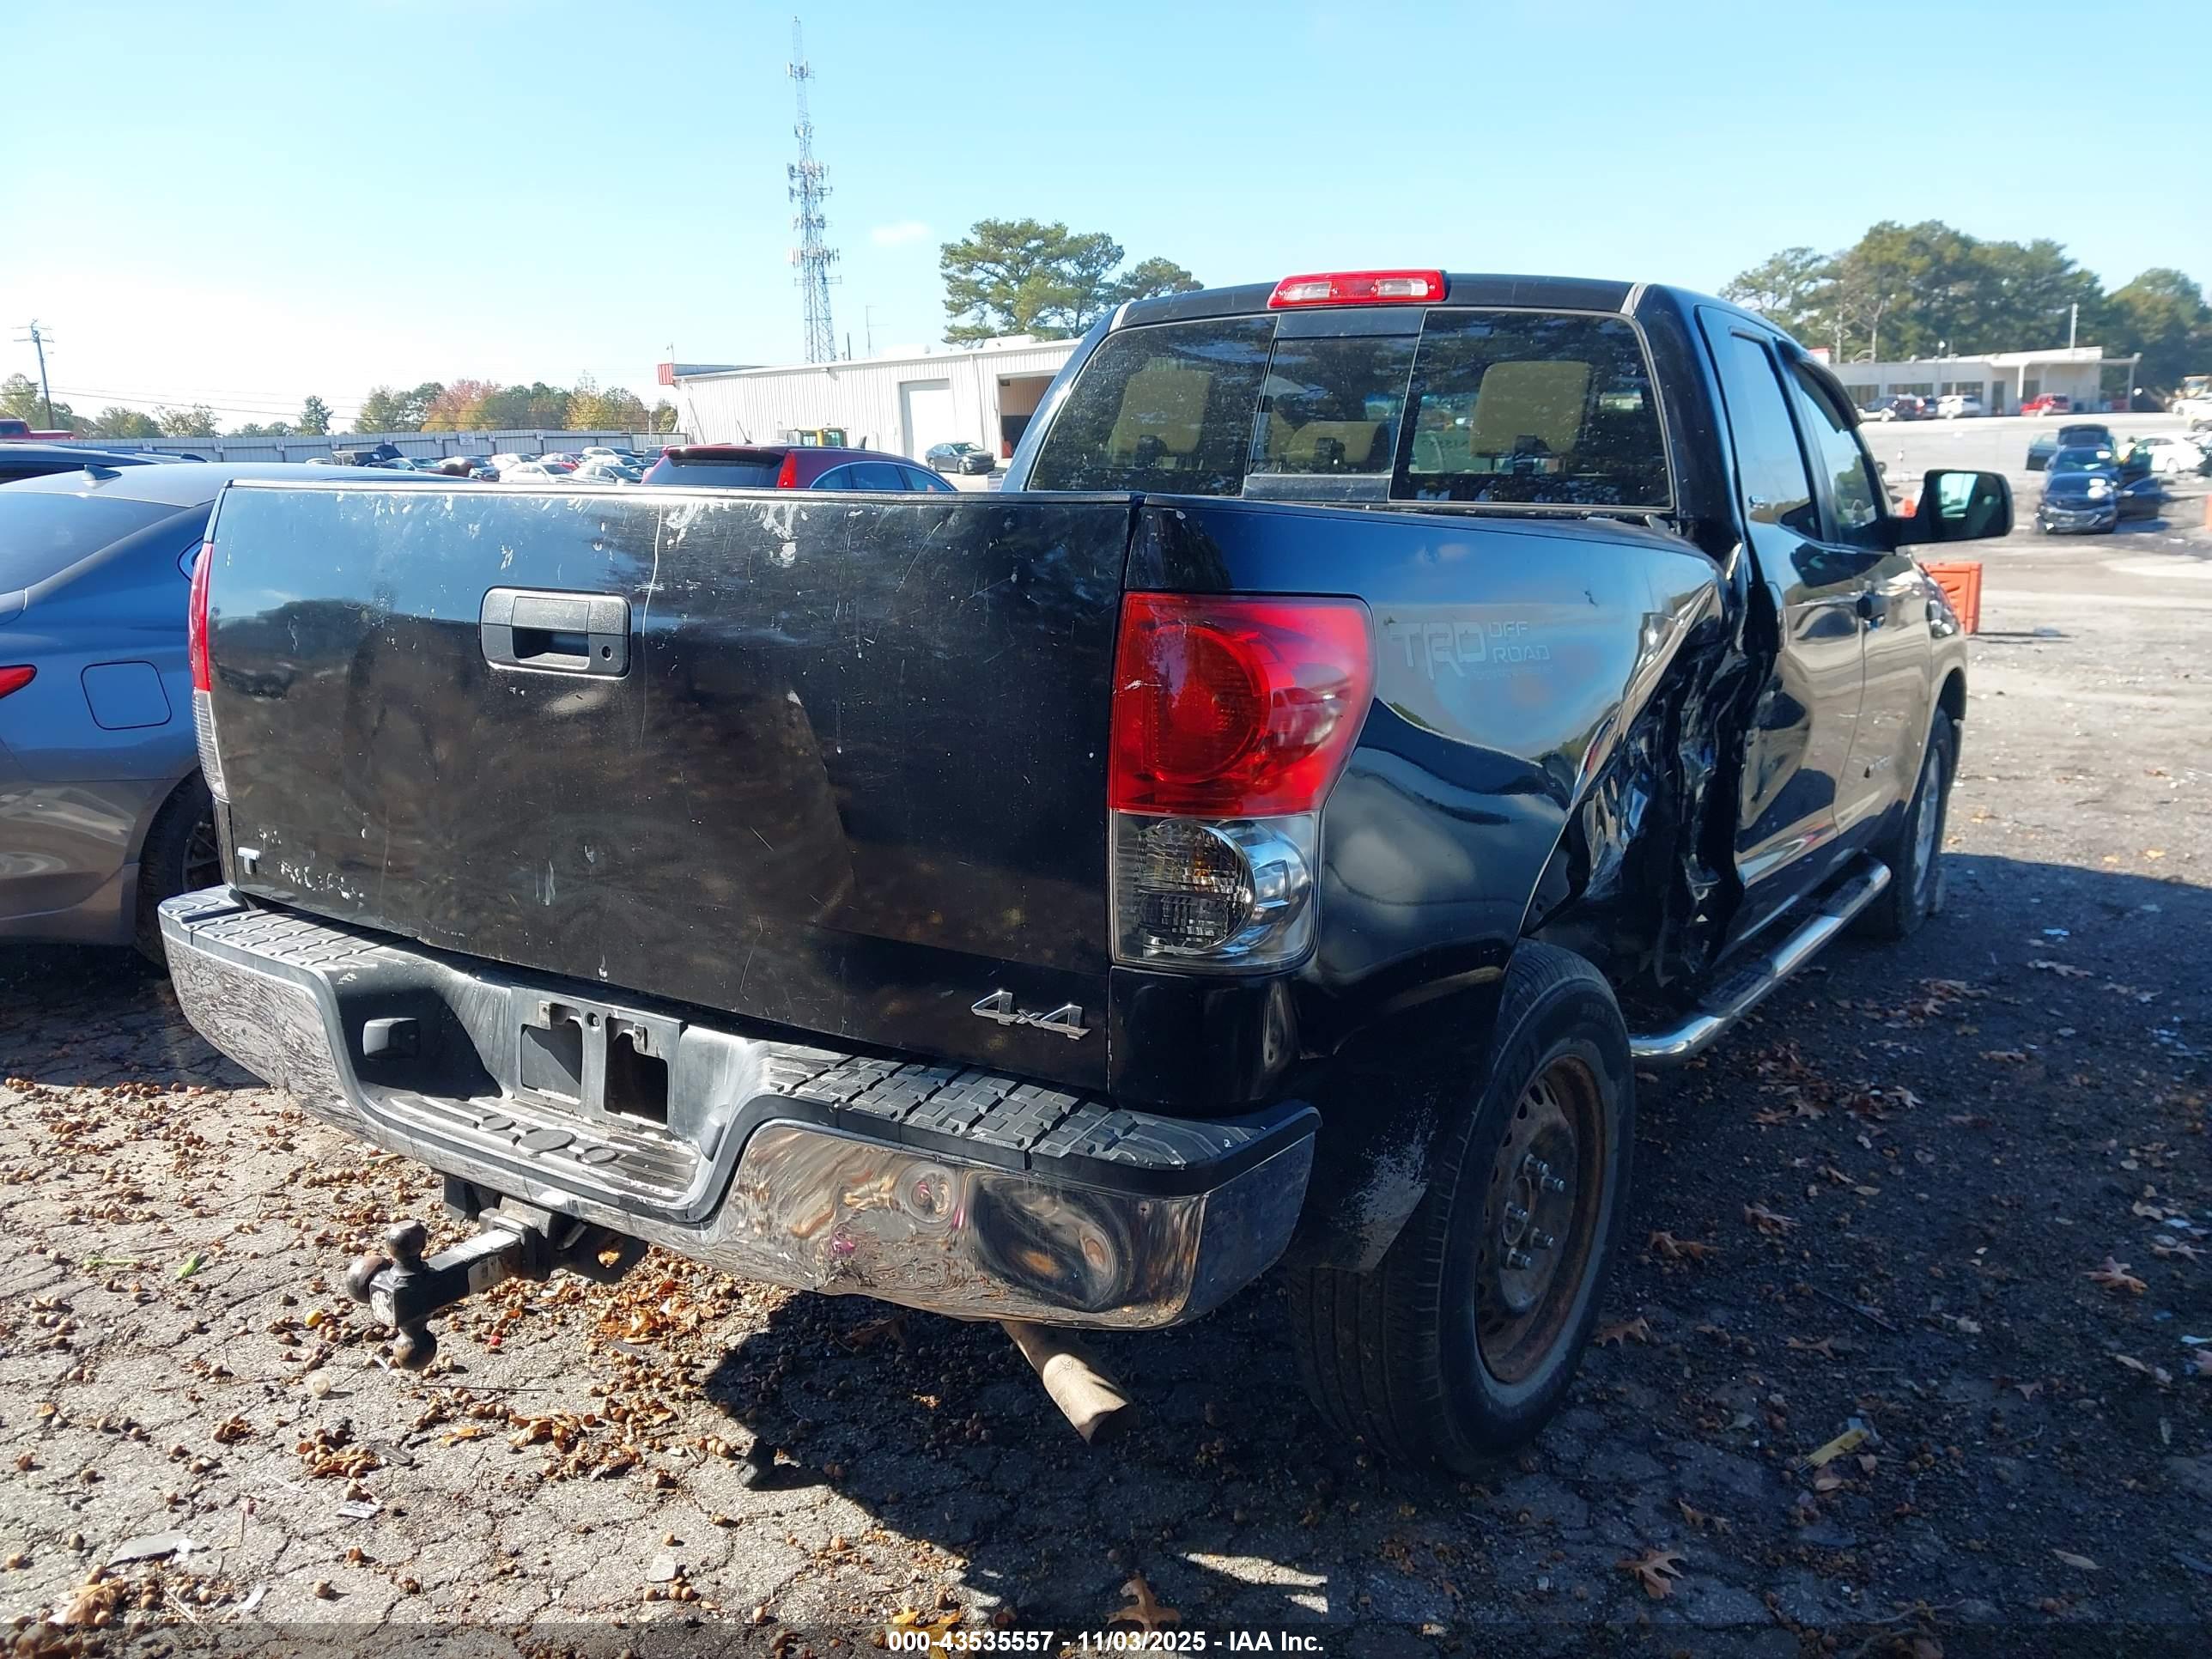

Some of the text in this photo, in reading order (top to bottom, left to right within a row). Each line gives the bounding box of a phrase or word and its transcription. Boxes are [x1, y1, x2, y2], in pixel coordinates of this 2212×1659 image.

[1490, 621, 1528, 638] OFF
[1388, 622, 1486, 680] TRD
[1492, 646, 1551, 664] ROAD
